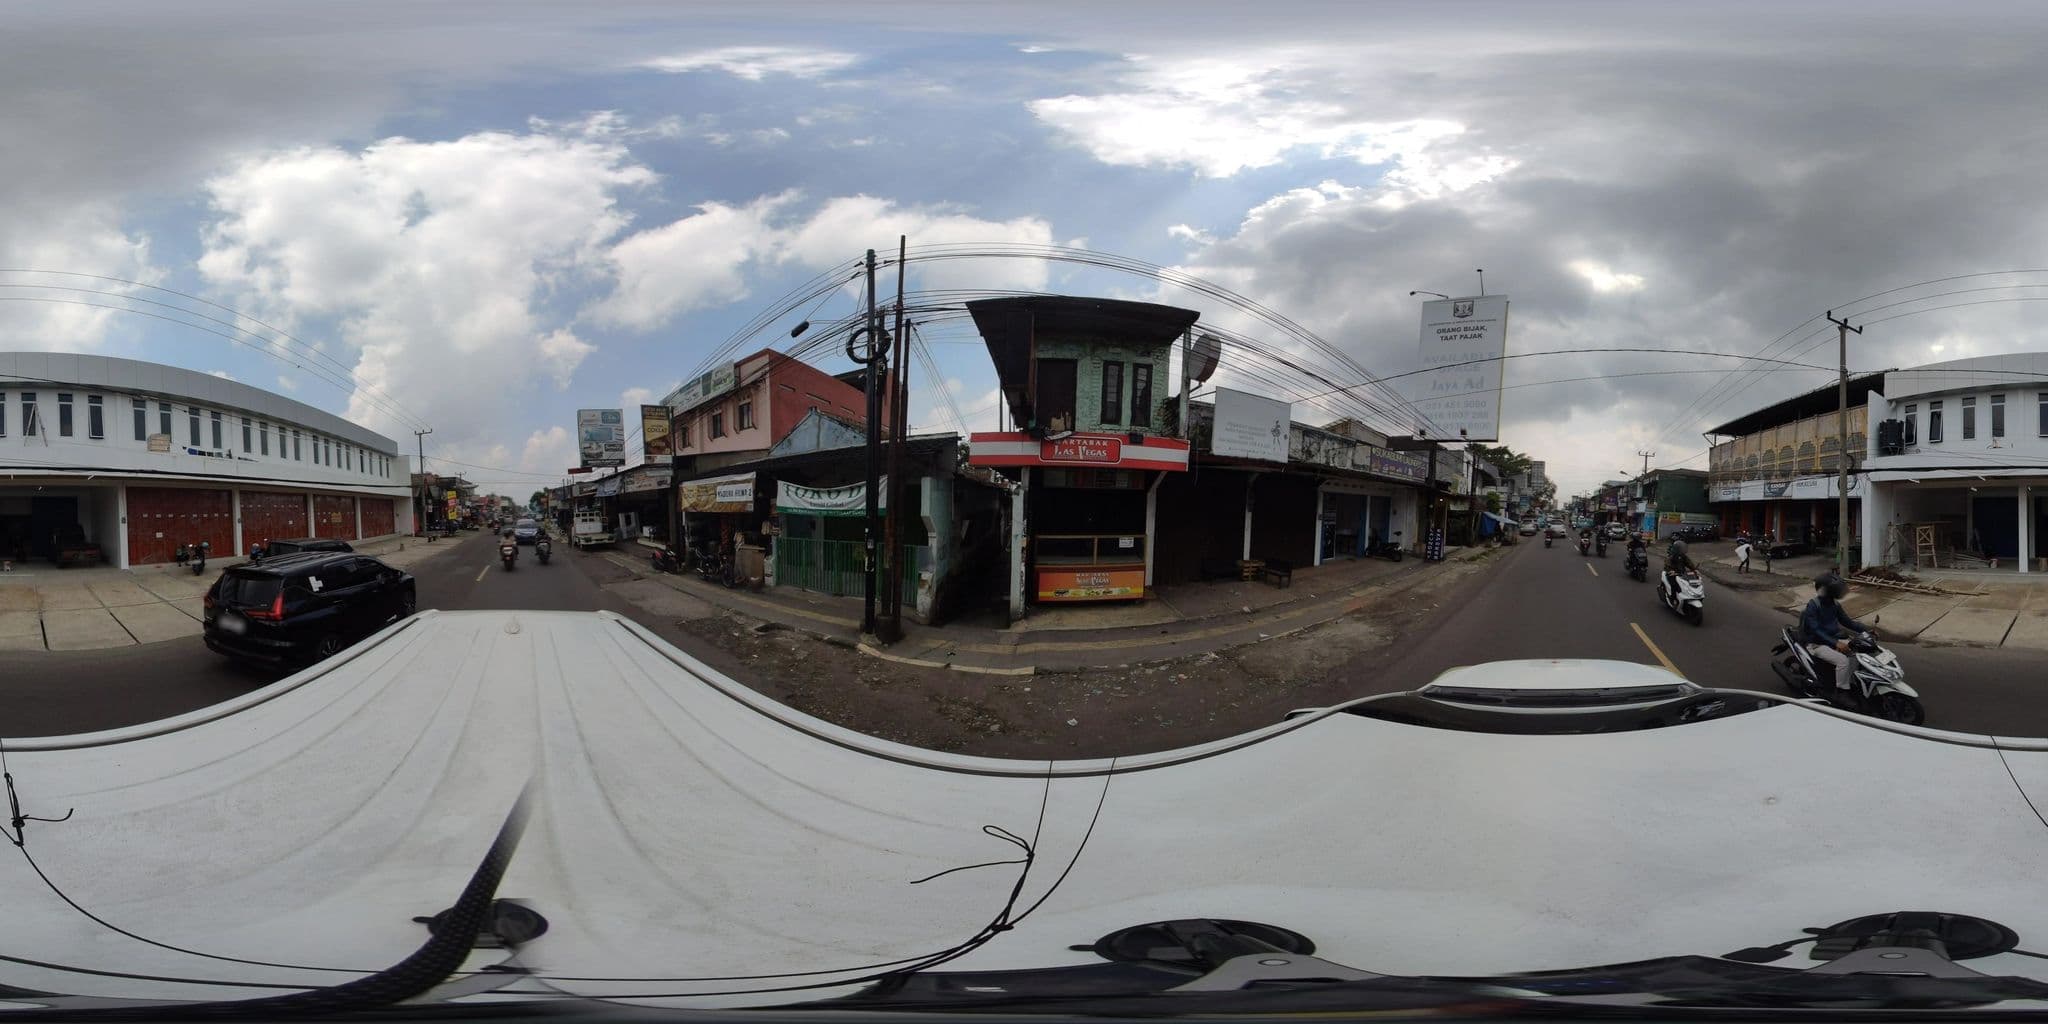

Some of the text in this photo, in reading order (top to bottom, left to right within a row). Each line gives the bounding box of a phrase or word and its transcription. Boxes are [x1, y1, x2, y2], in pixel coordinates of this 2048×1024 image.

[1436, 325, 1488, 334] ORANG BIJAK,
[1078, 445, 1107, 459] VEGAS
